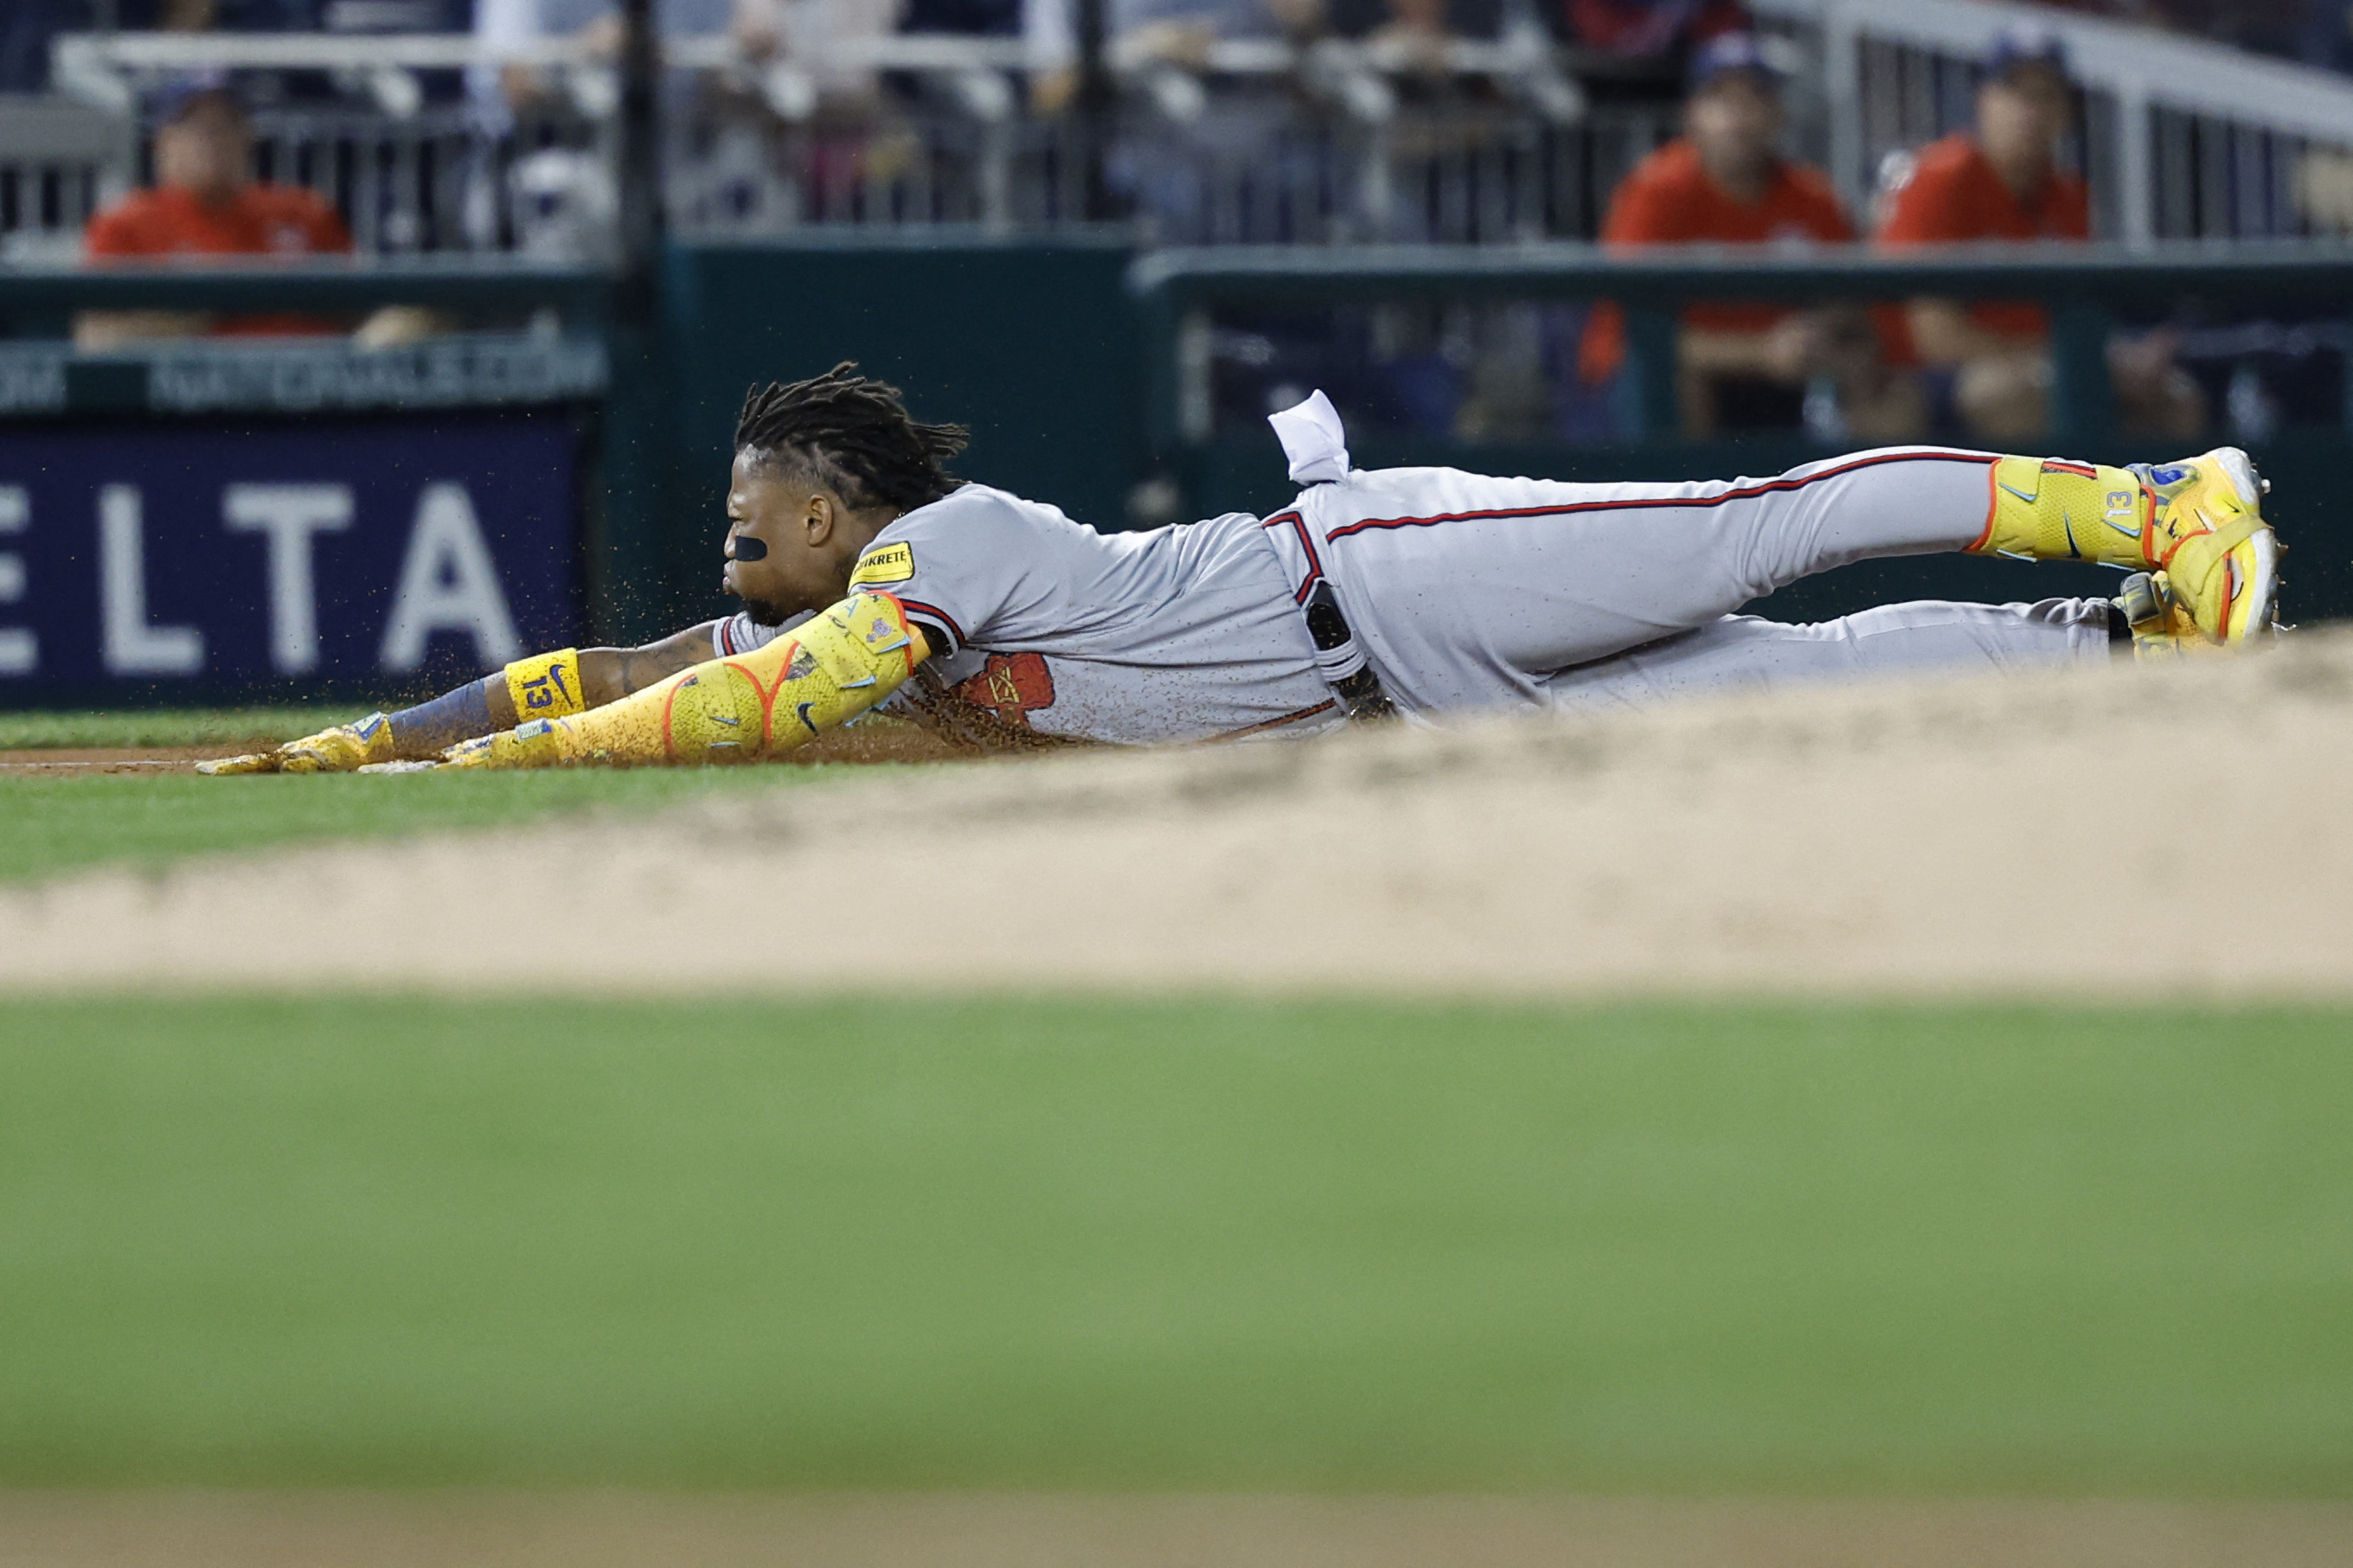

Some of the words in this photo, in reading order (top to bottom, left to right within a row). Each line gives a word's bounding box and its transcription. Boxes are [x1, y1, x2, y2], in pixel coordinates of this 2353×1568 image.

[2106, 491, 2133, 518] 13
[853, 550, 907, 574] IKRETE
[523, 675, 554, 709] 13
